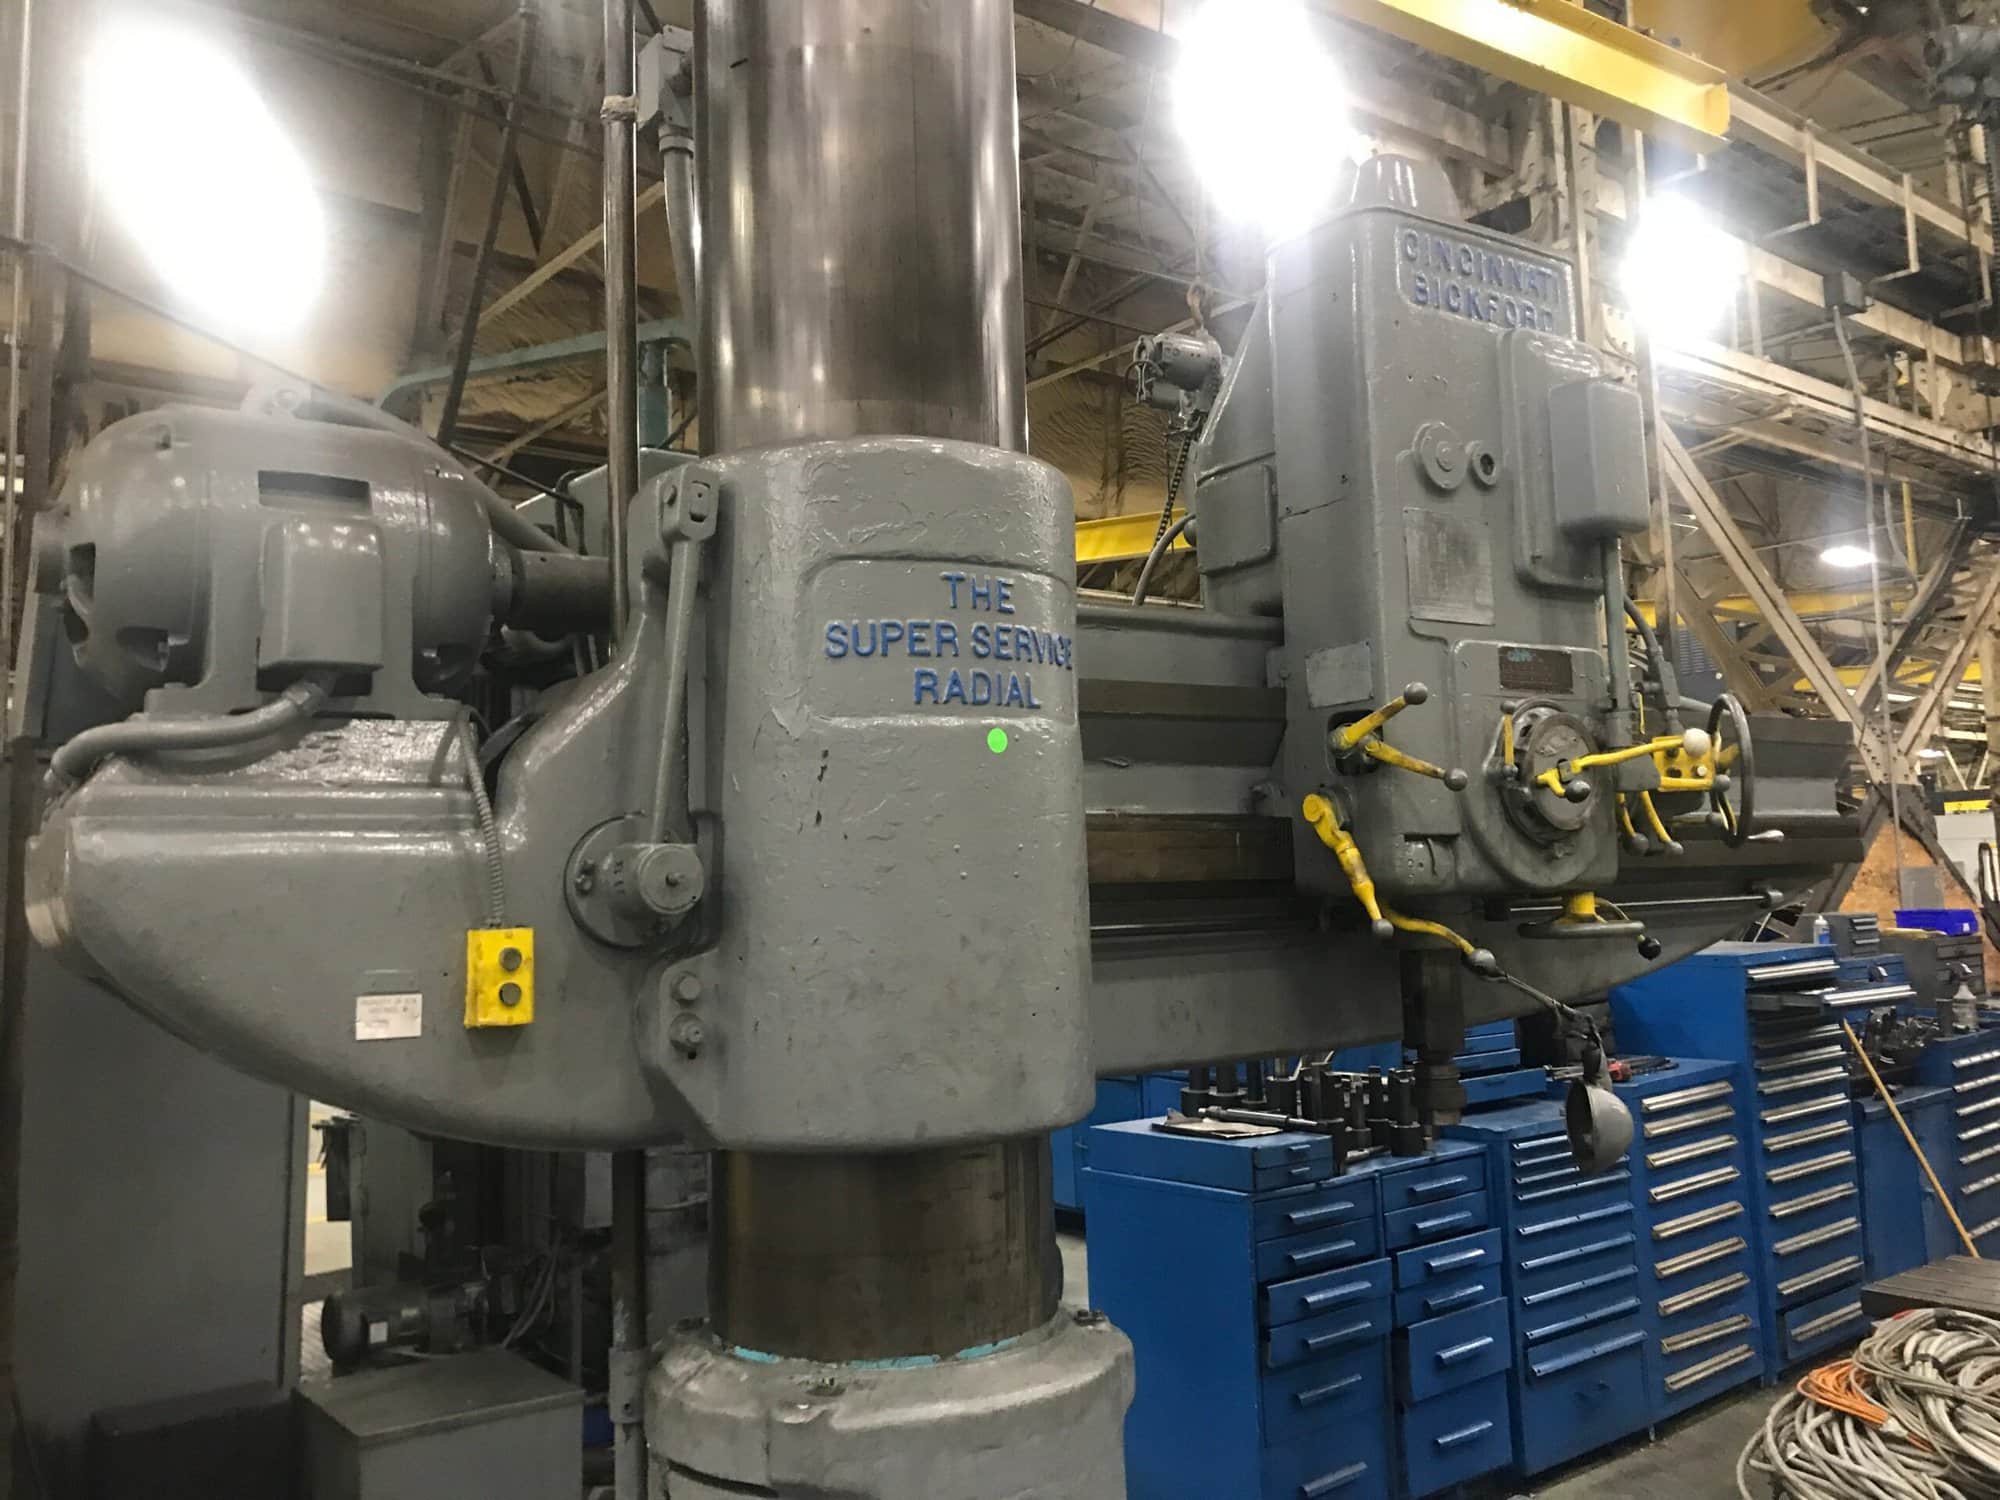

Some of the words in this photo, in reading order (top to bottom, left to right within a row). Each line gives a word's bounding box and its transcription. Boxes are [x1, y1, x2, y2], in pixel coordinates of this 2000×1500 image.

[1404, 229, 1561, 303] CINCINNATI
[940, 571, 1016, 614] THE
[824, 619, 959, 659] SUPER
[970, 621, 1073, 671] SERVICE
[913, 667, 1041, 709] RADIAL
